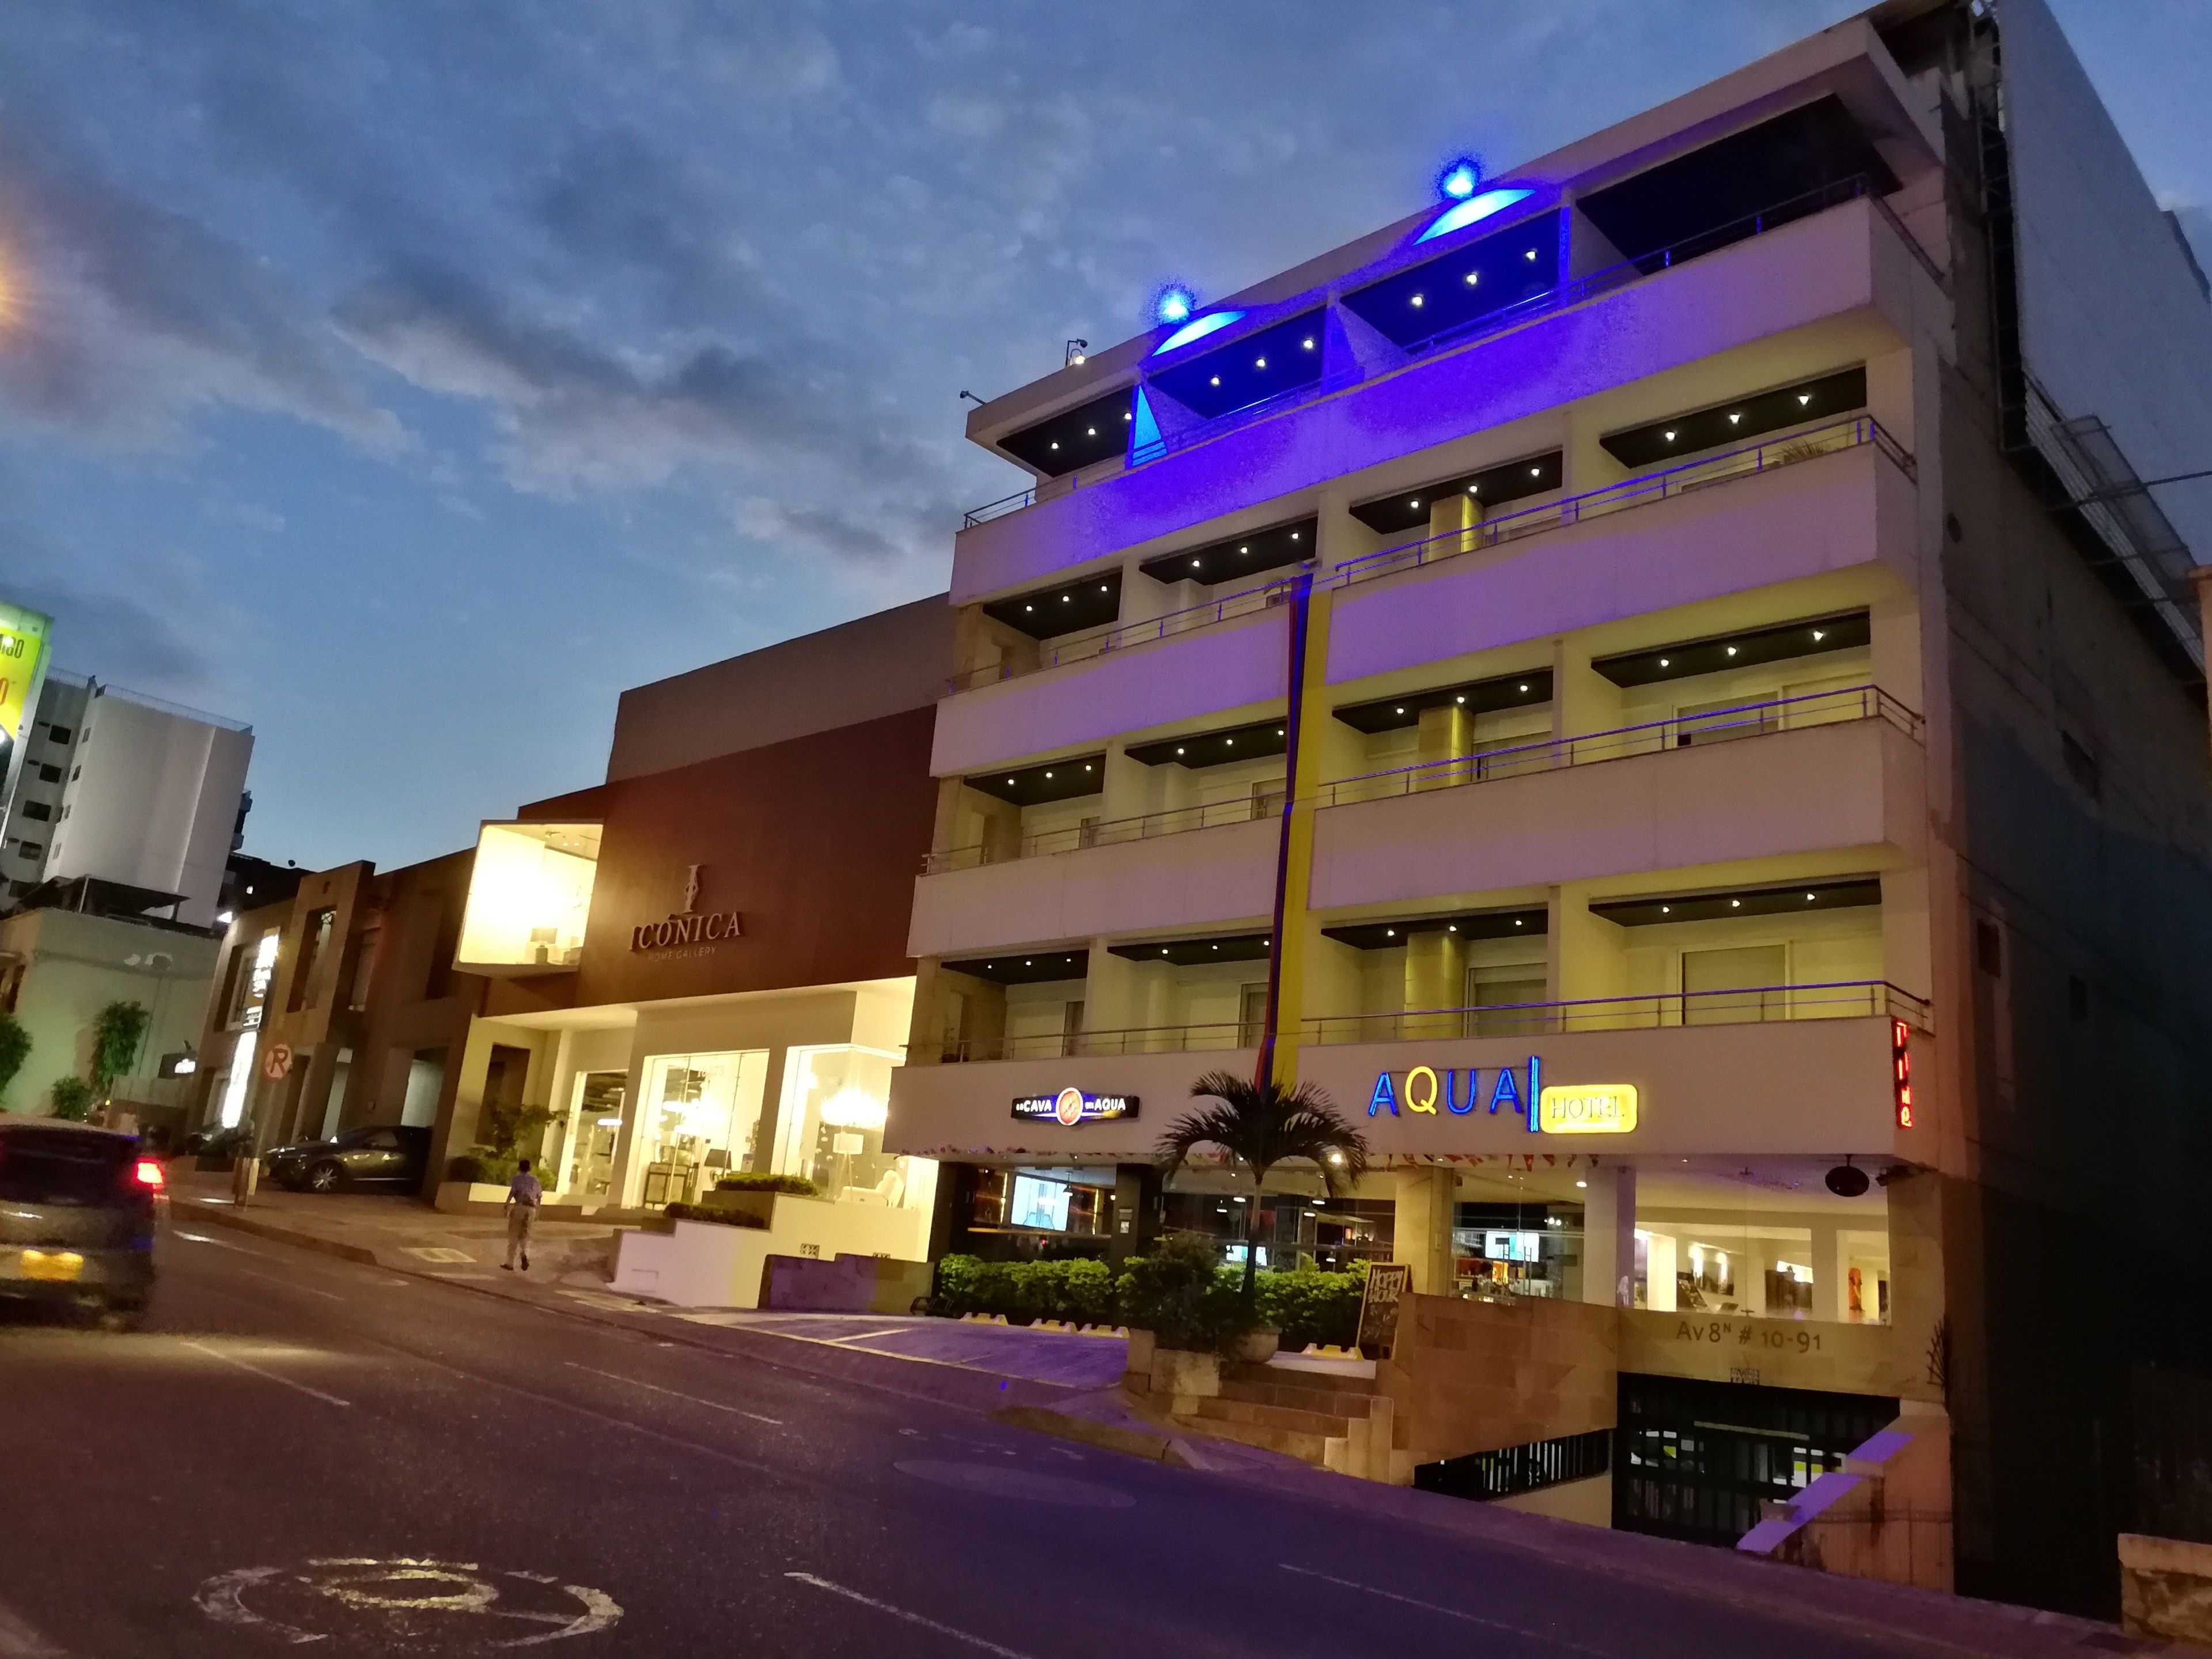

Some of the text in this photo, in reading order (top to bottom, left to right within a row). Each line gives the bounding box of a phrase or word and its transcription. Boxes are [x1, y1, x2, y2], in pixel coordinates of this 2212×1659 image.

[1368, 1066, 1523, 1116] AQUA
[1024, 1100, 1052, 1112] CAVA
[1094, 1098, 1126, 1111] AQUA
[1551, 1096, 1624, 1119] HOTEL
[1738, 1325, 1752, 1344] #
[1761, 1331, 1820, 1353] 10-91
